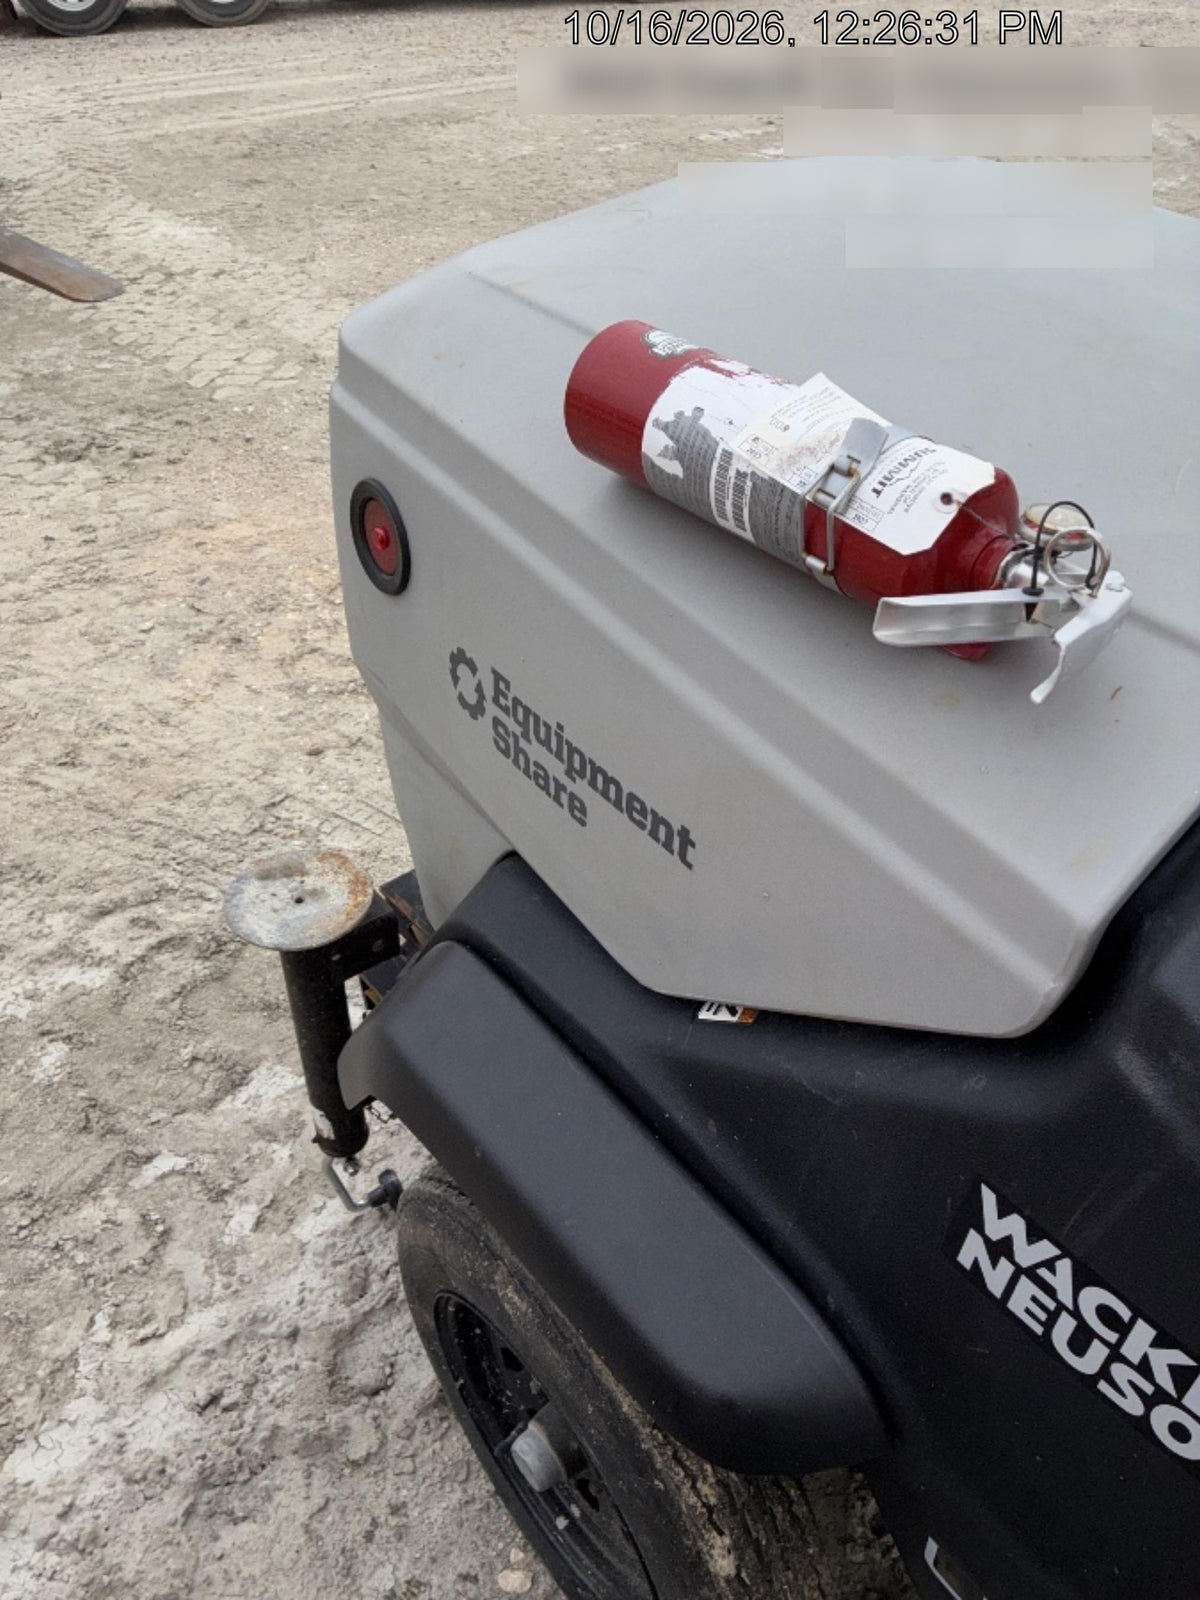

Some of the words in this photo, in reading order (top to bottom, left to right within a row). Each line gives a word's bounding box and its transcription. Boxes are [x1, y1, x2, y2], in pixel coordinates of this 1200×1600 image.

[871, 447, 937, 499] SUMMIT
[491, 666, 696, 871] Equipment
[491, 715, 588, 828] Share
